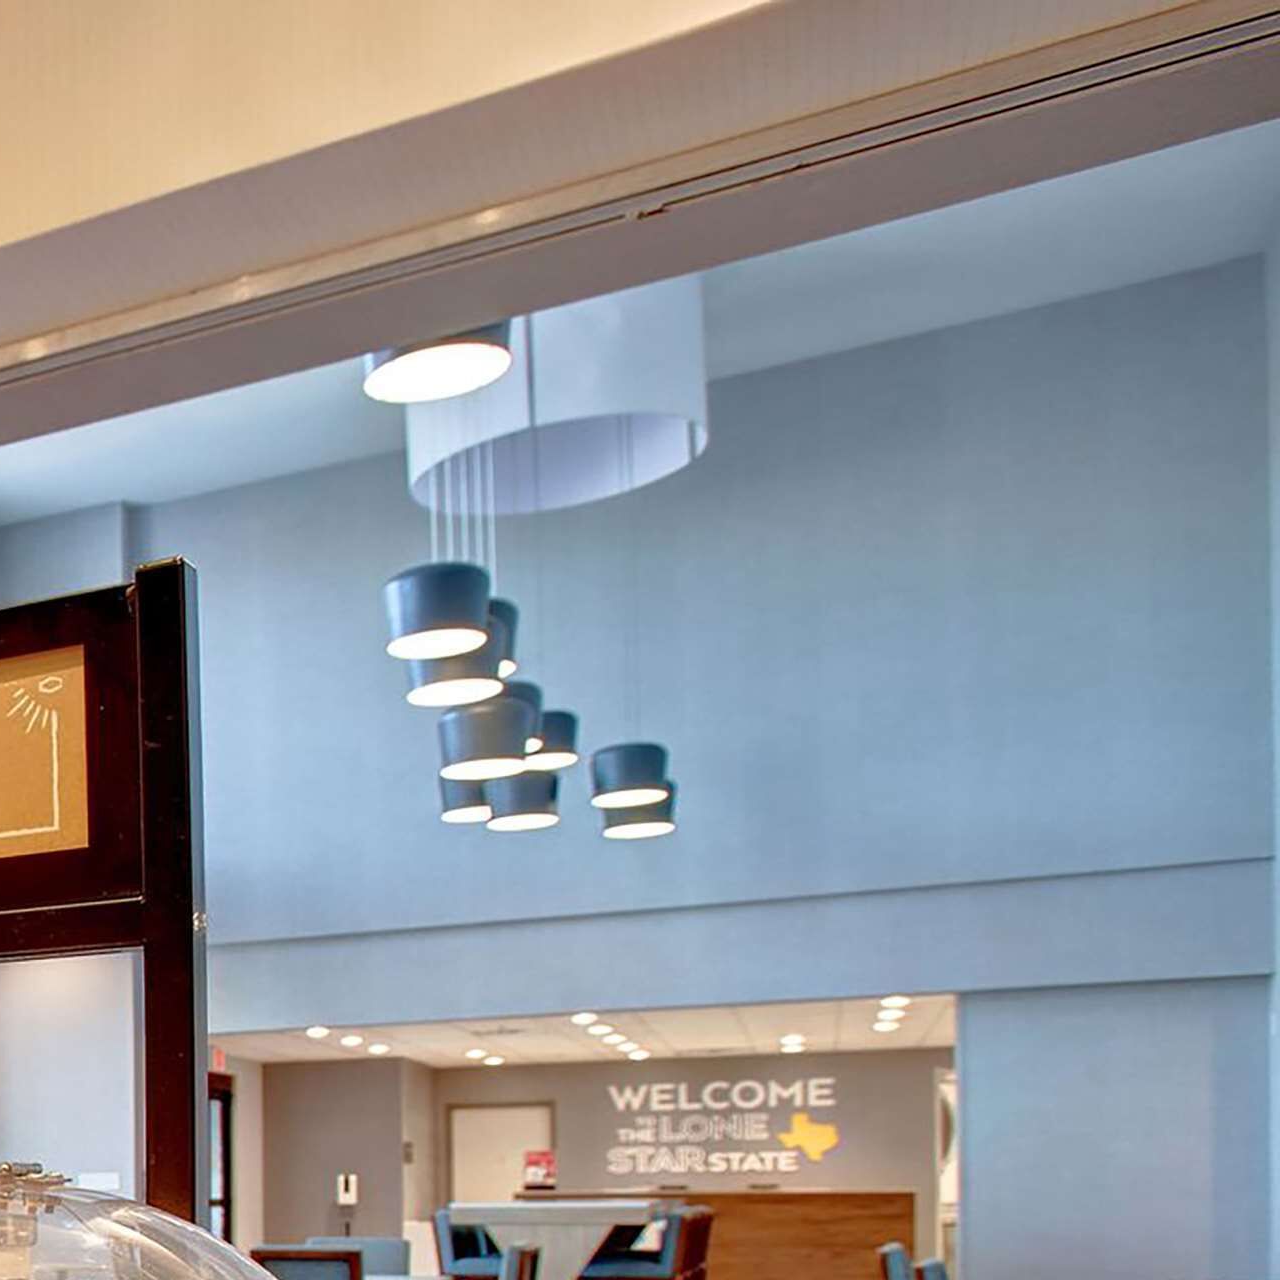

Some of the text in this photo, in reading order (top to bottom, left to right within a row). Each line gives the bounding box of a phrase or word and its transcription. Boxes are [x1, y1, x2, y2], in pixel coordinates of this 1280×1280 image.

[607, 1077, 837, 1112] WELCOME
[617, 1113, 770, 1143] THE LONE
[605, 1145, 800, 1175] STAR STATE
